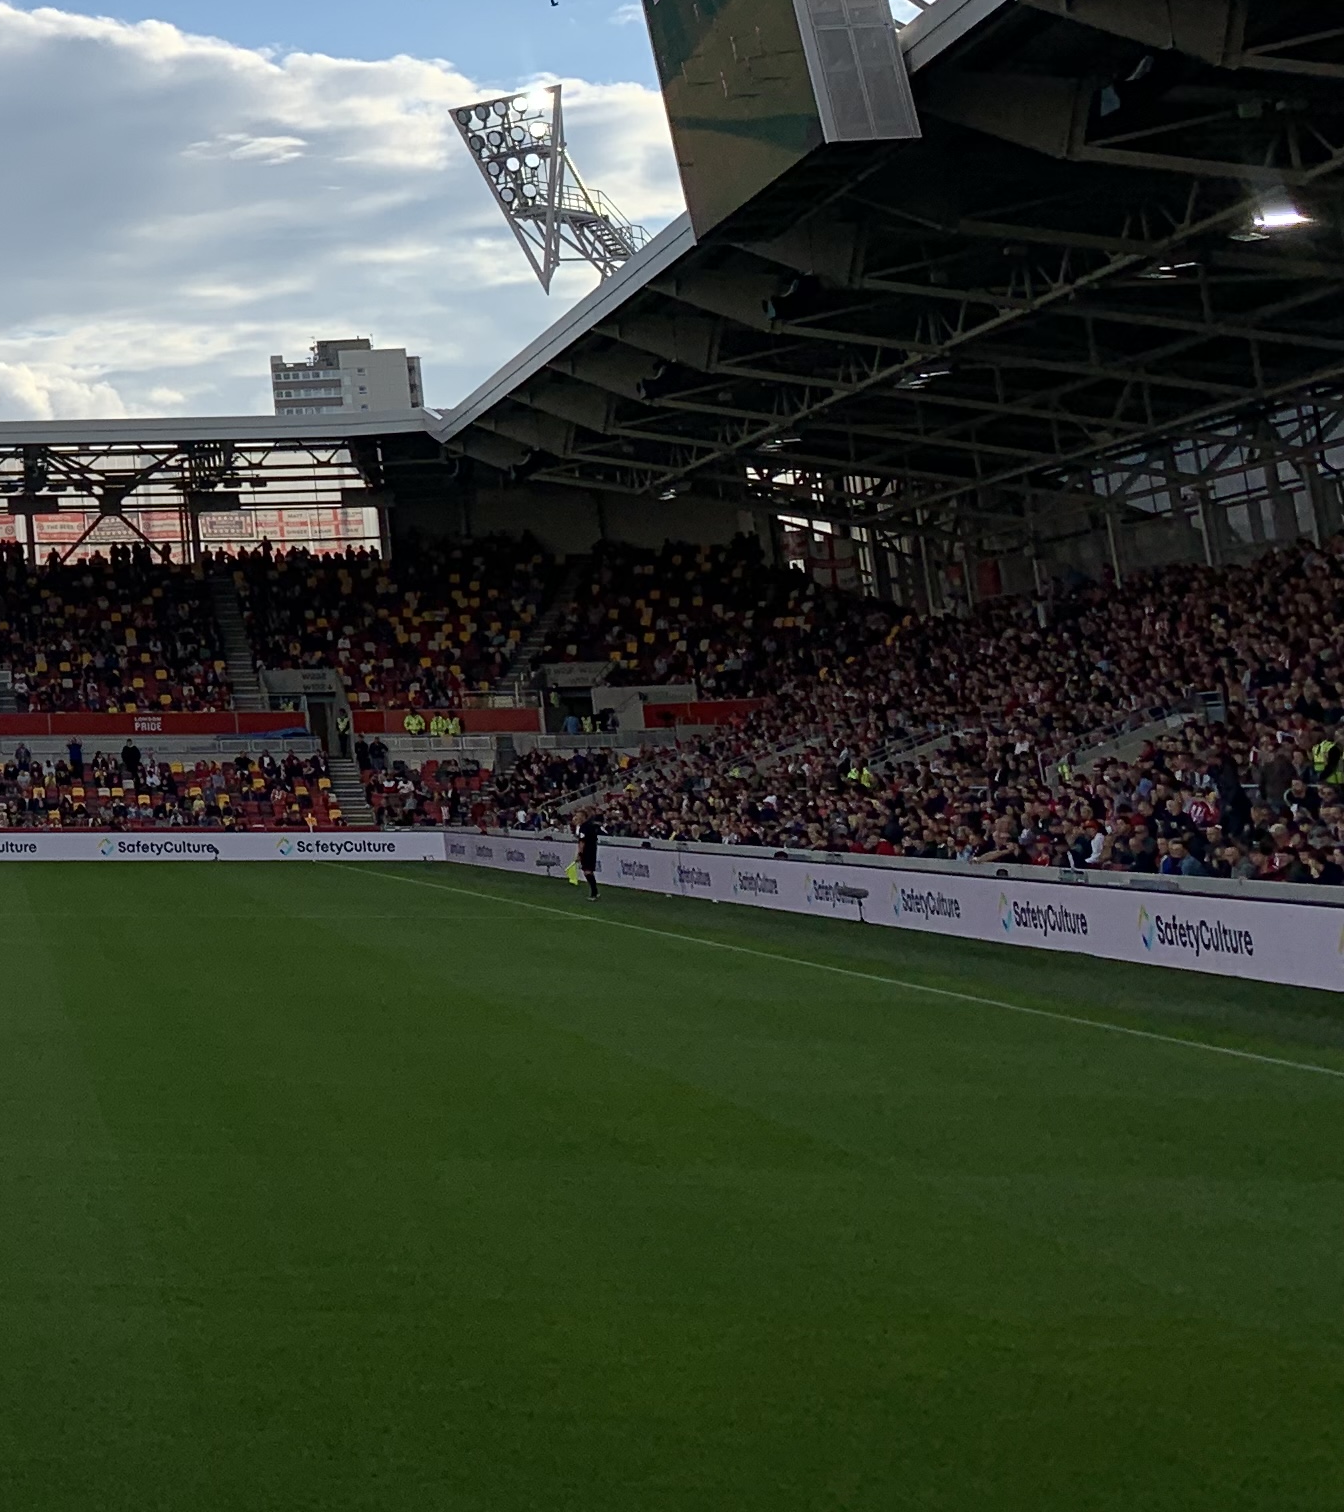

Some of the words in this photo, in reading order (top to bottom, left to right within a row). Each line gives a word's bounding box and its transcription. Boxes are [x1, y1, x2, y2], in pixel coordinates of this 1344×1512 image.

[134, 722, 162, 732] PRIDE
[118, 841, 215, 855] SafetyCulture
[900, 888, 961, 919] SafetyCulture
[1012, 901, 1088, 937] SafetyCulture
[1155, 914, 1254, 956] SafetyCulture
